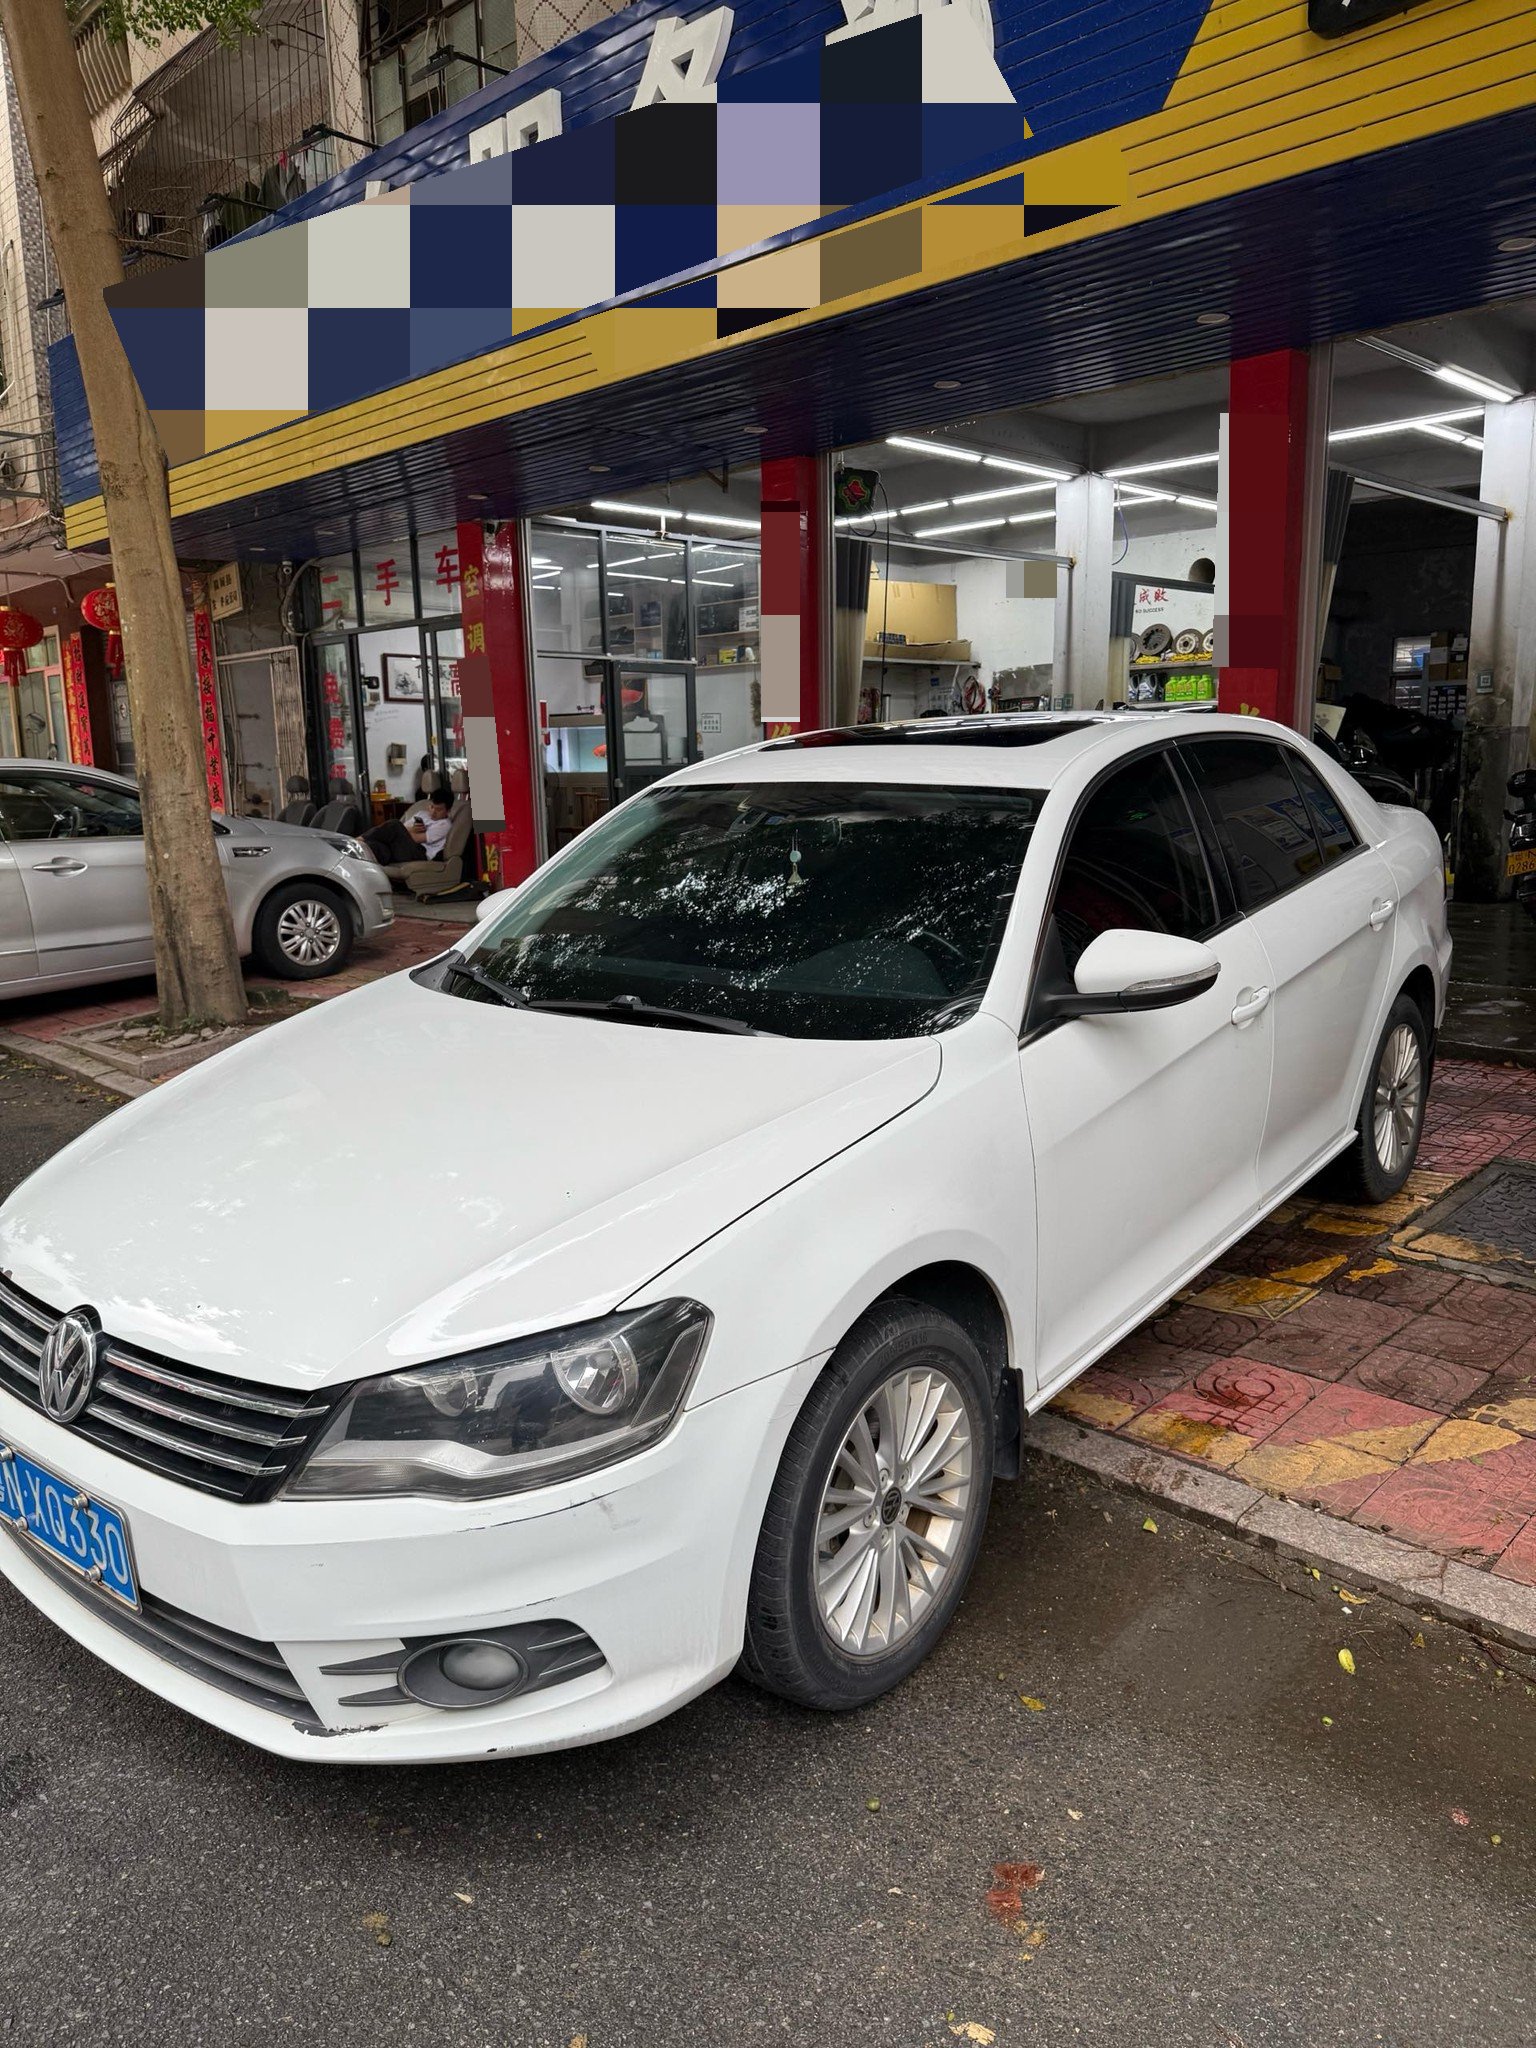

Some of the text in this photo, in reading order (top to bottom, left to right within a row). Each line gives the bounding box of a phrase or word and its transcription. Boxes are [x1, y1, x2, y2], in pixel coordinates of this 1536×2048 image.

[322, 545, 462, 609] 二手车
[464, 564, 485, 653] 空调
